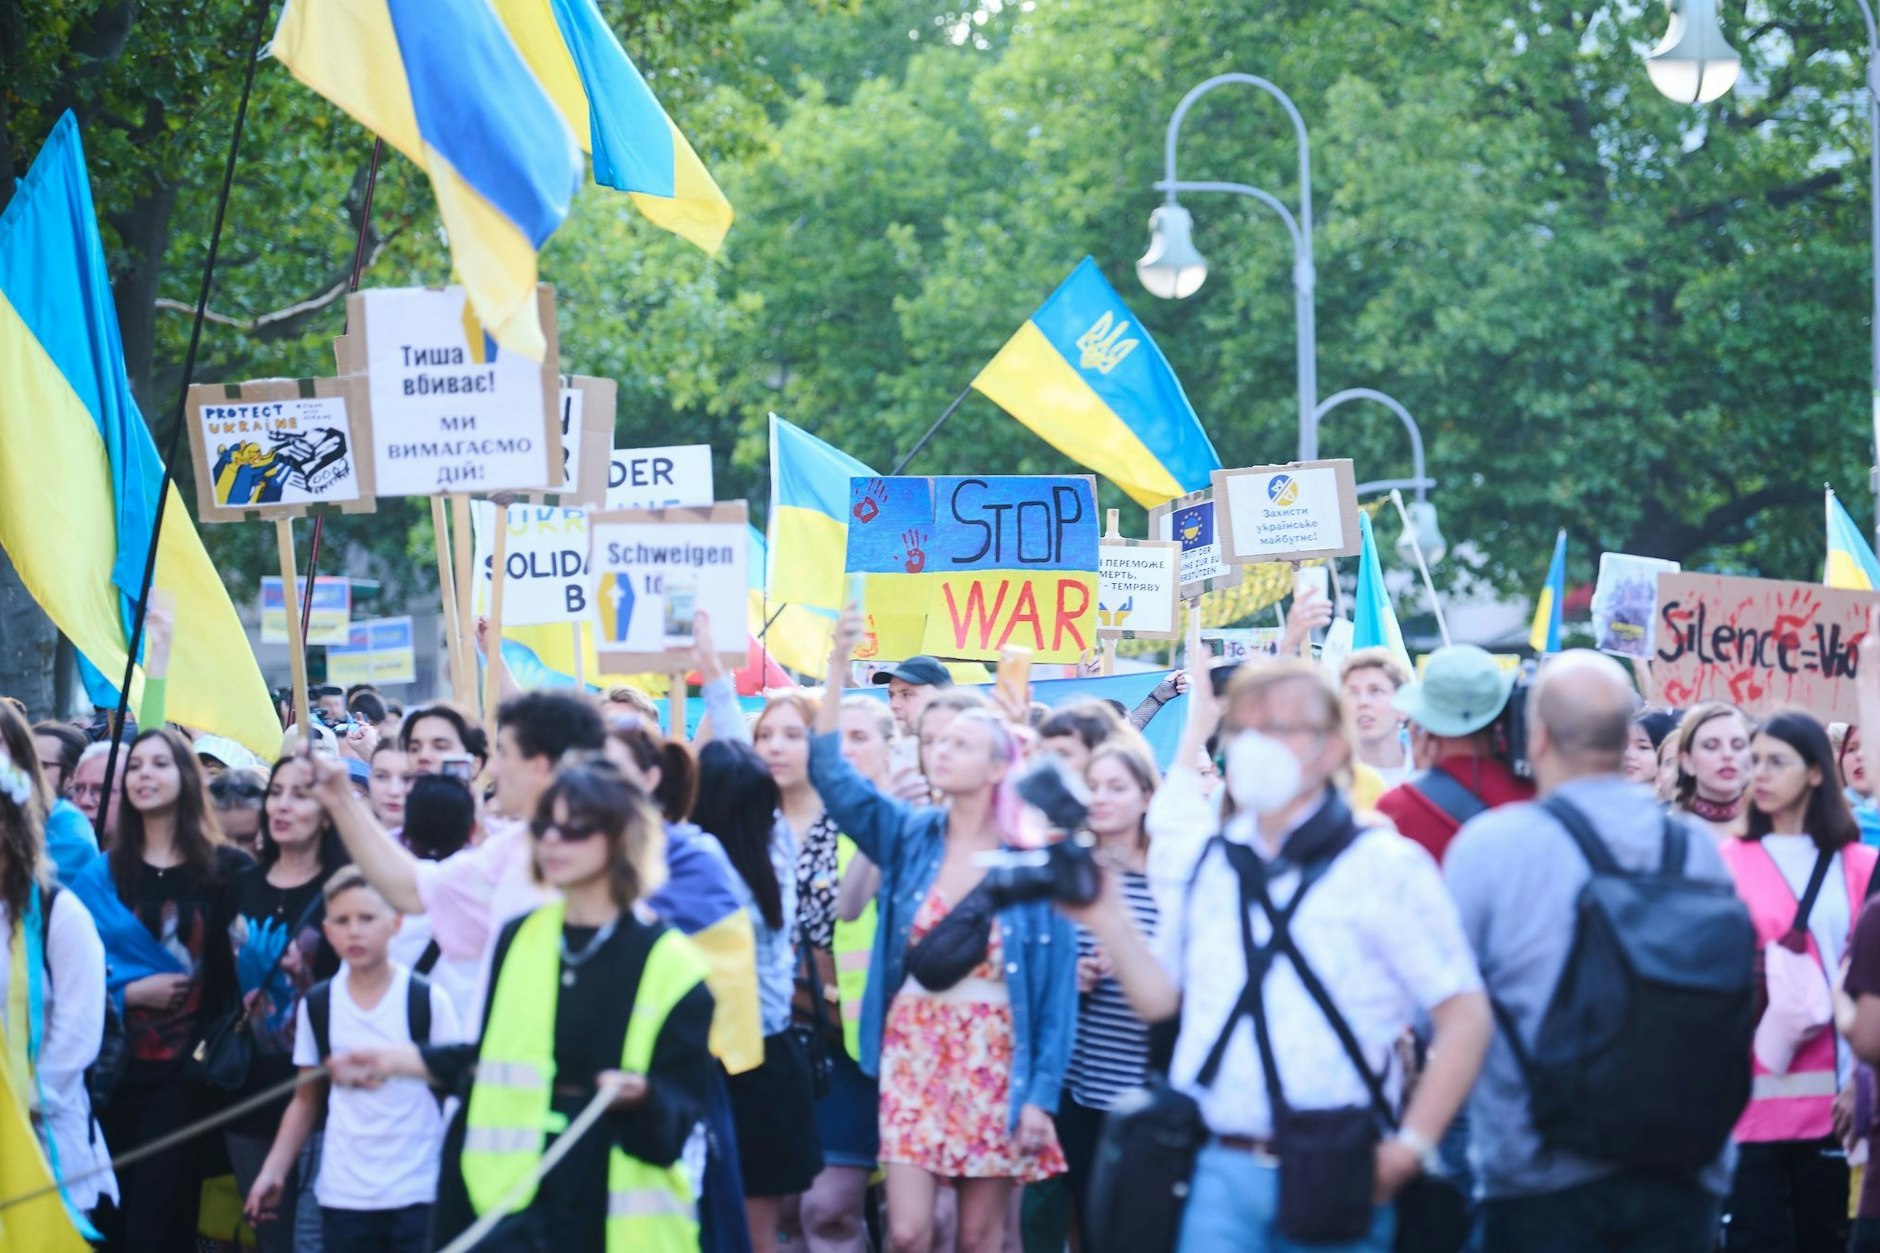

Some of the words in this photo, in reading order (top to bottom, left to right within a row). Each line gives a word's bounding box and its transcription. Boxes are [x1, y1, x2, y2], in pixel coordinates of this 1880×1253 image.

[401, 345, 464, 367] Тиша
[403, 370, 495, 396] вбиває!
[206, 404, 283, 420] PROTECT
[208, 416, 298, 434] UKRAINE
[440, 416, 476, 431] МИ
[388, 438, 532, 459] ВИМАГАЄМО
[437, 461, 485, 484] ДІЙ!
[608, 457, 674, 489] DER
[951, 479, 1082, 564] STOP
[1263, 508, 1309, 518] Захисти
[1256, 519, 1319, 534] українське
[608, 541, 733, 567] Schweigen
[1105, 559, 1165, 569] ПЕРЕМОЖЕ
[1111, 582, 1161, 592] ТЕМРЯВУ
[942, 579, 1090, 651] WAR
